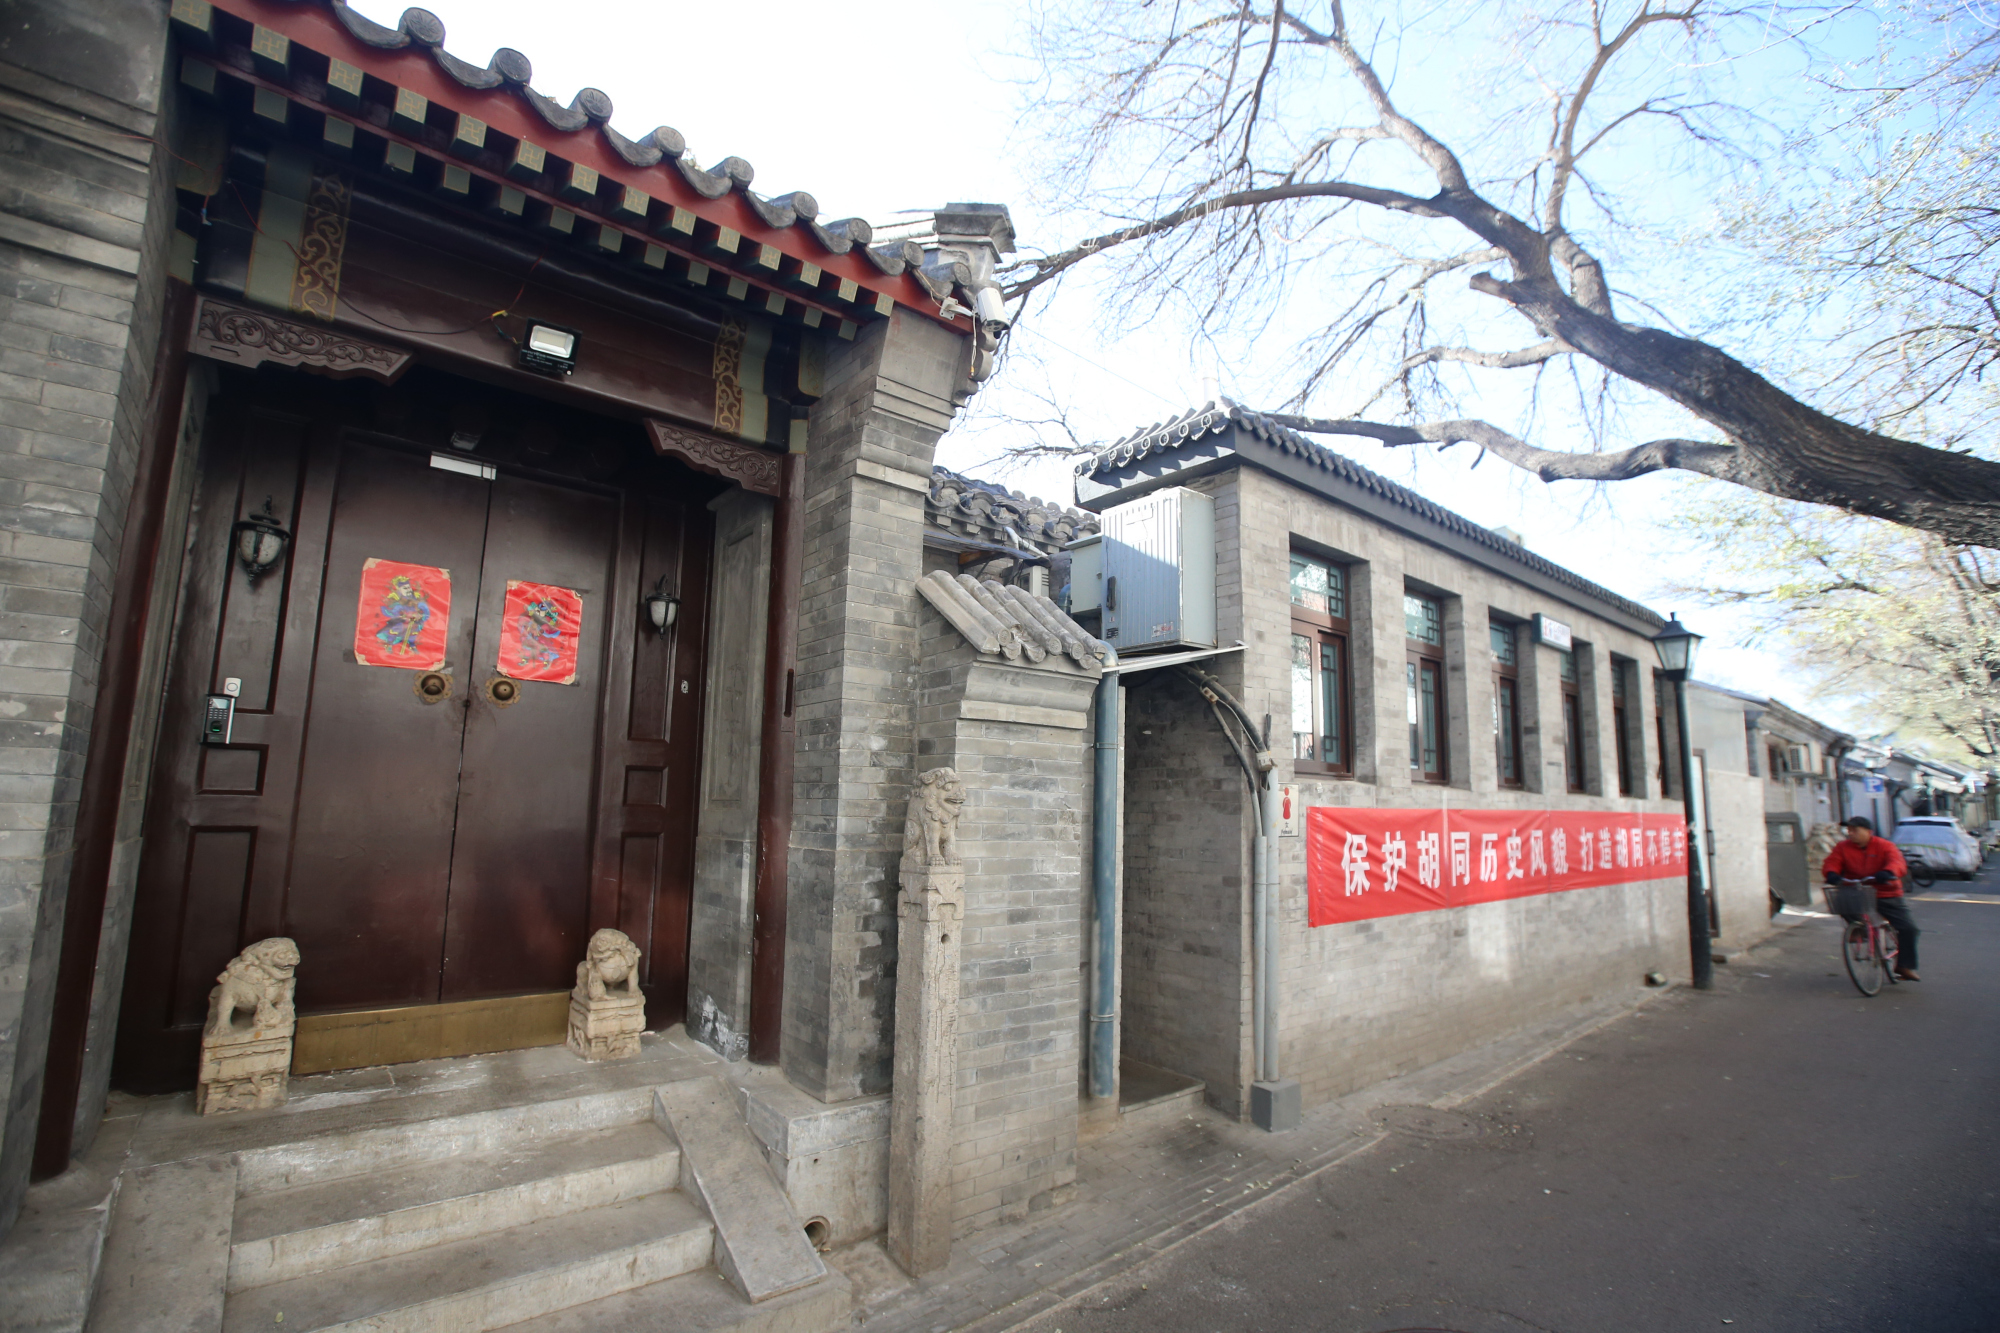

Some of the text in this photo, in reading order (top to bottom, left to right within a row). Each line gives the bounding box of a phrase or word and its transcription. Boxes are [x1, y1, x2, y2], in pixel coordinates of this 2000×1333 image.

[1865, 778, 1881, 792] P
[1341, 827, 1684, 897] 保护胡同历史风貌 打造胡同不停车
